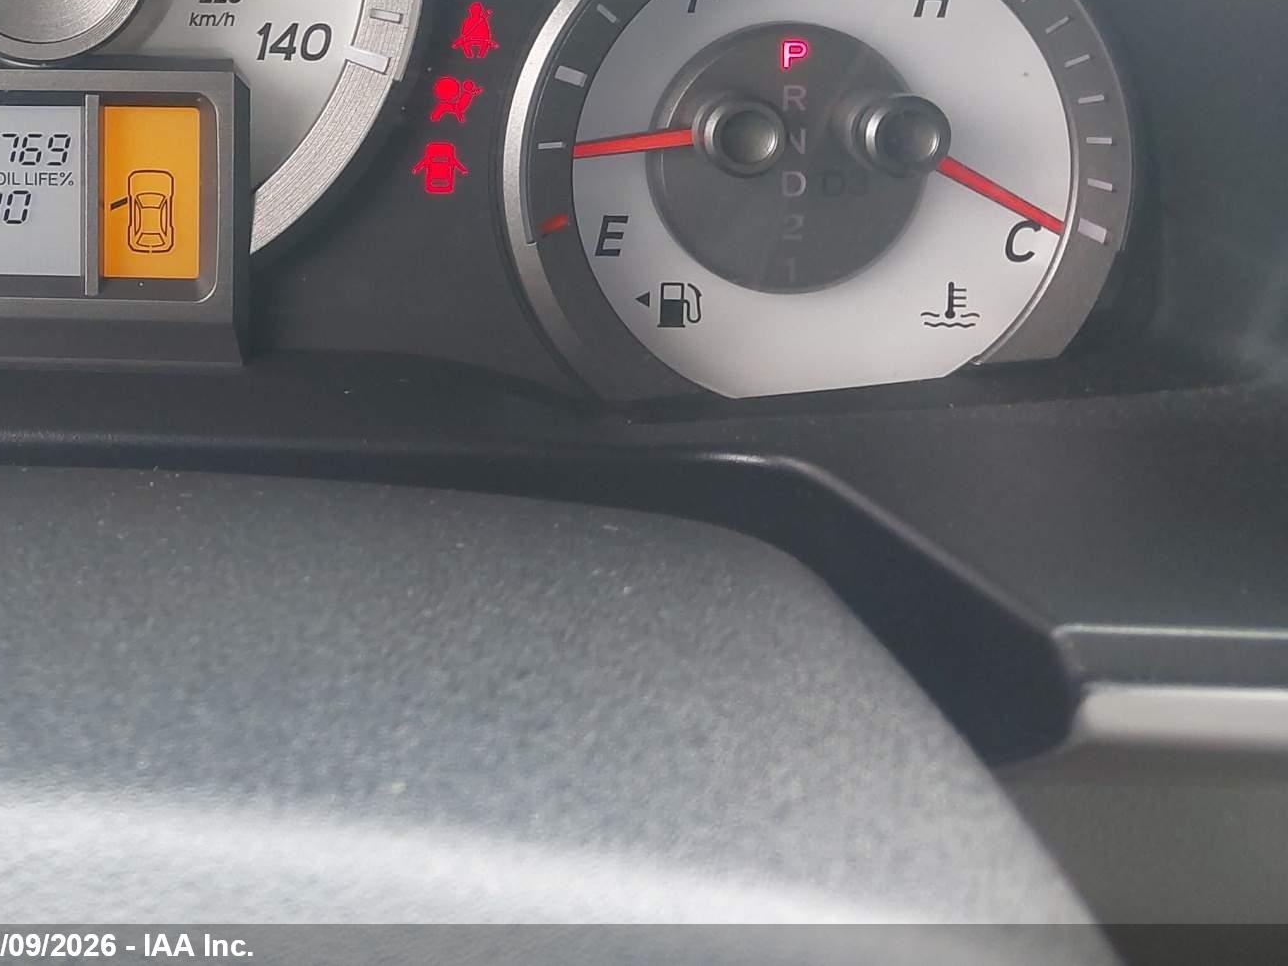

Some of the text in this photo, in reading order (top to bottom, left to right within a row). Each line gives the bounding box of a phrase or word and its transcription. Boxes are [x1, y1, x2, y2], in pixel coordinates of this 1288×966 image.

[189, 11, 235, 28] km/h
[256, 22, 331, 61] 140
[782, 40, 808, 69] P
[782, 85, 808, 111] R
[24, 171, 74, 187] LIFE%
[783, 171, 807, 197] D
[595, 215, 628, 256] E
[782, 214, 805, 240] 2
[1005, 221, 1042, 262] C
